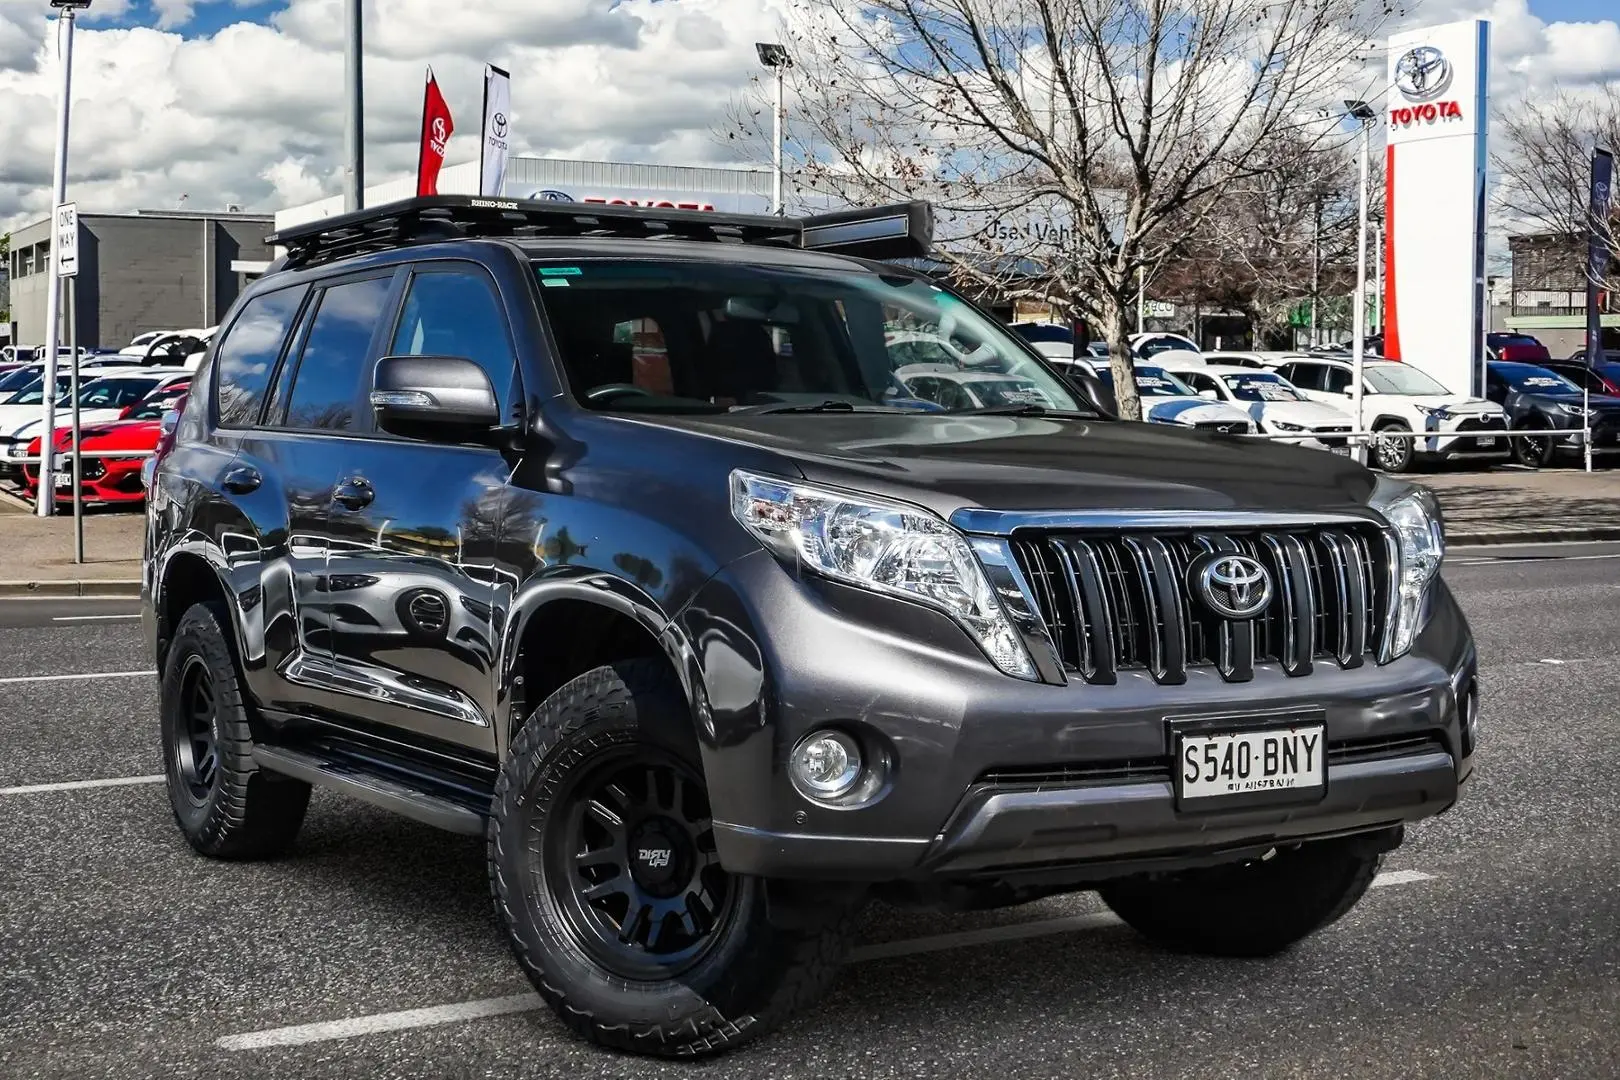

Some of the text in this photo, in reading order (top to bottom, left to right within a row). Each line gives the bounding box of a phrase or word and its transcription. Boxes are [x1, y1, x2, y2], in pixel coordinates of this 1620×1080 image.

[1389, 101, 1463, 125] TOYOTA
[471, 199, 518, 210] RHINO-RACK
[59, 209, 74, 228] ONE
[59, 231, 75, 249] WAY
